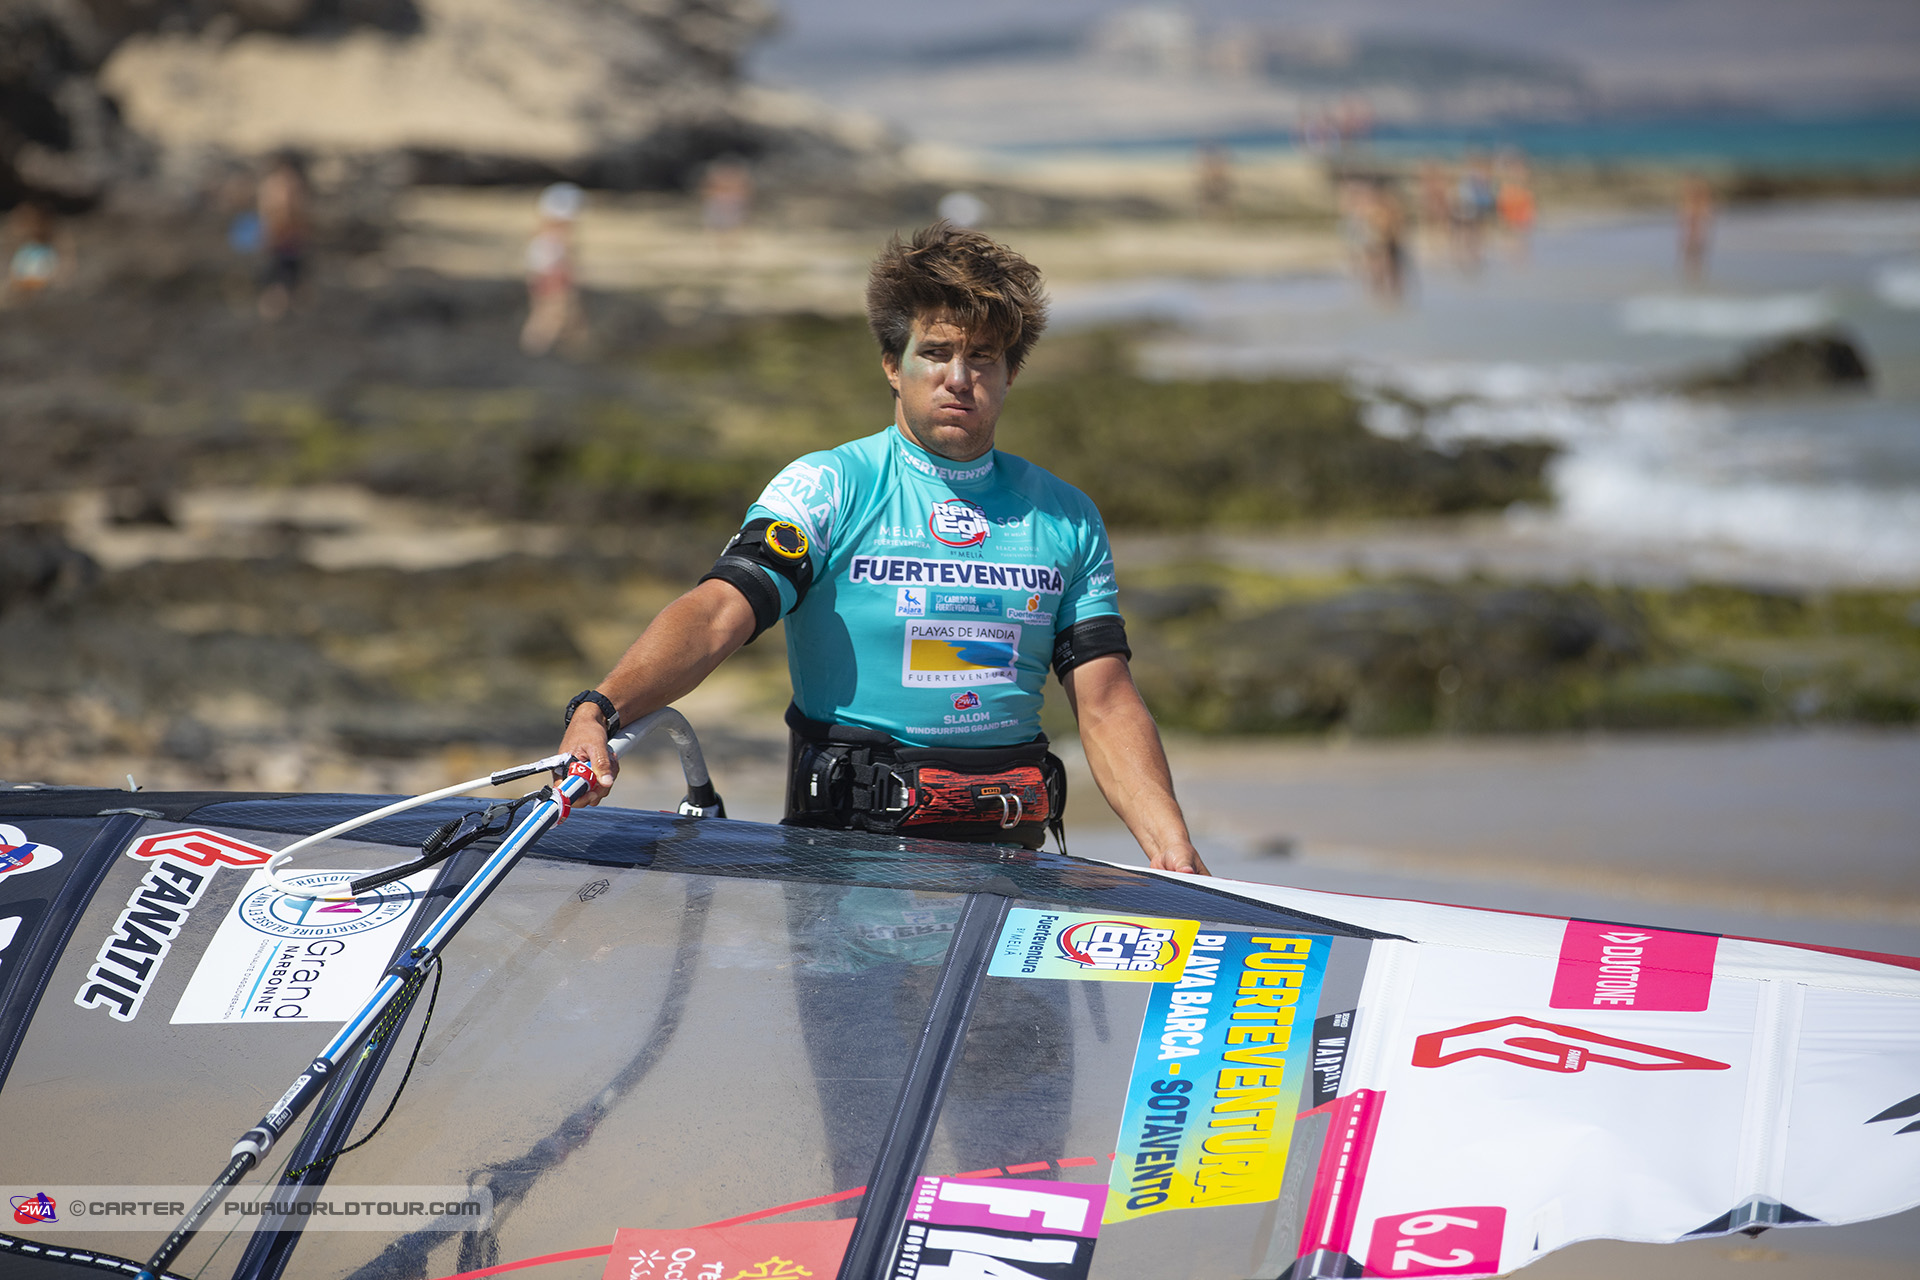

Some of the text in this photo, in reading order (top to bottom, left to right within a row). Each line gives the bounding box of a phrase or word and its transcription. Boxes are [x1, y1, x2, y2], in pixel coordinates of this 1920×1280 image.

[900, 448, 993, 480] FUERTEVENTUR
[771, 476, 831, 528] PWA
[996, 515, 1030, 528] SOL
[873, 539, 931, 549] FUERTEVENTURA
[935, 514, 991, 539] Egli
[853, 558, 1063, 592] FUERTEVENTURA
[935, 603, 980, 612] FUERTEVENTURA
[969, 596, 977, 604] DE
[911, 626, 1015, 640] PLAYAS DE JANDIA
[908, 670, 1013, 682] FUERTEVENTURA
[906, 719, 1019, 735] WINDSURFING GRAND SLAM
[943, 712, 990, 725] SLALOM
[82, 861, 204, 1017] FANATIC
[252, 913, 289, 933] GLISSE
[290, 919, 376, 936] TERRITOIRE
[1021, 914, 1060, 973] Fuerteventura
[1075, 925, 1142, 971] Egli
[1129, 928, 1174, 972] René
[1174, 935, 1227, 990] PLAYA
[254, 945, 300, 1012] NARBONNE
[272, 939, 345, 1018] Grand
[1592, 945, 1644, 1006] DUOTONE
[1157, 991, 1213, 1060] BARCA
[1190, 936, 1312, 1205] FUERTEVENTURA
[1125, 1078, 1193, 1211] SOTAVENTO
[913, 1177, 940, 1220] PIERRE
[1391, 1212, 1480, 1272] 6.2
